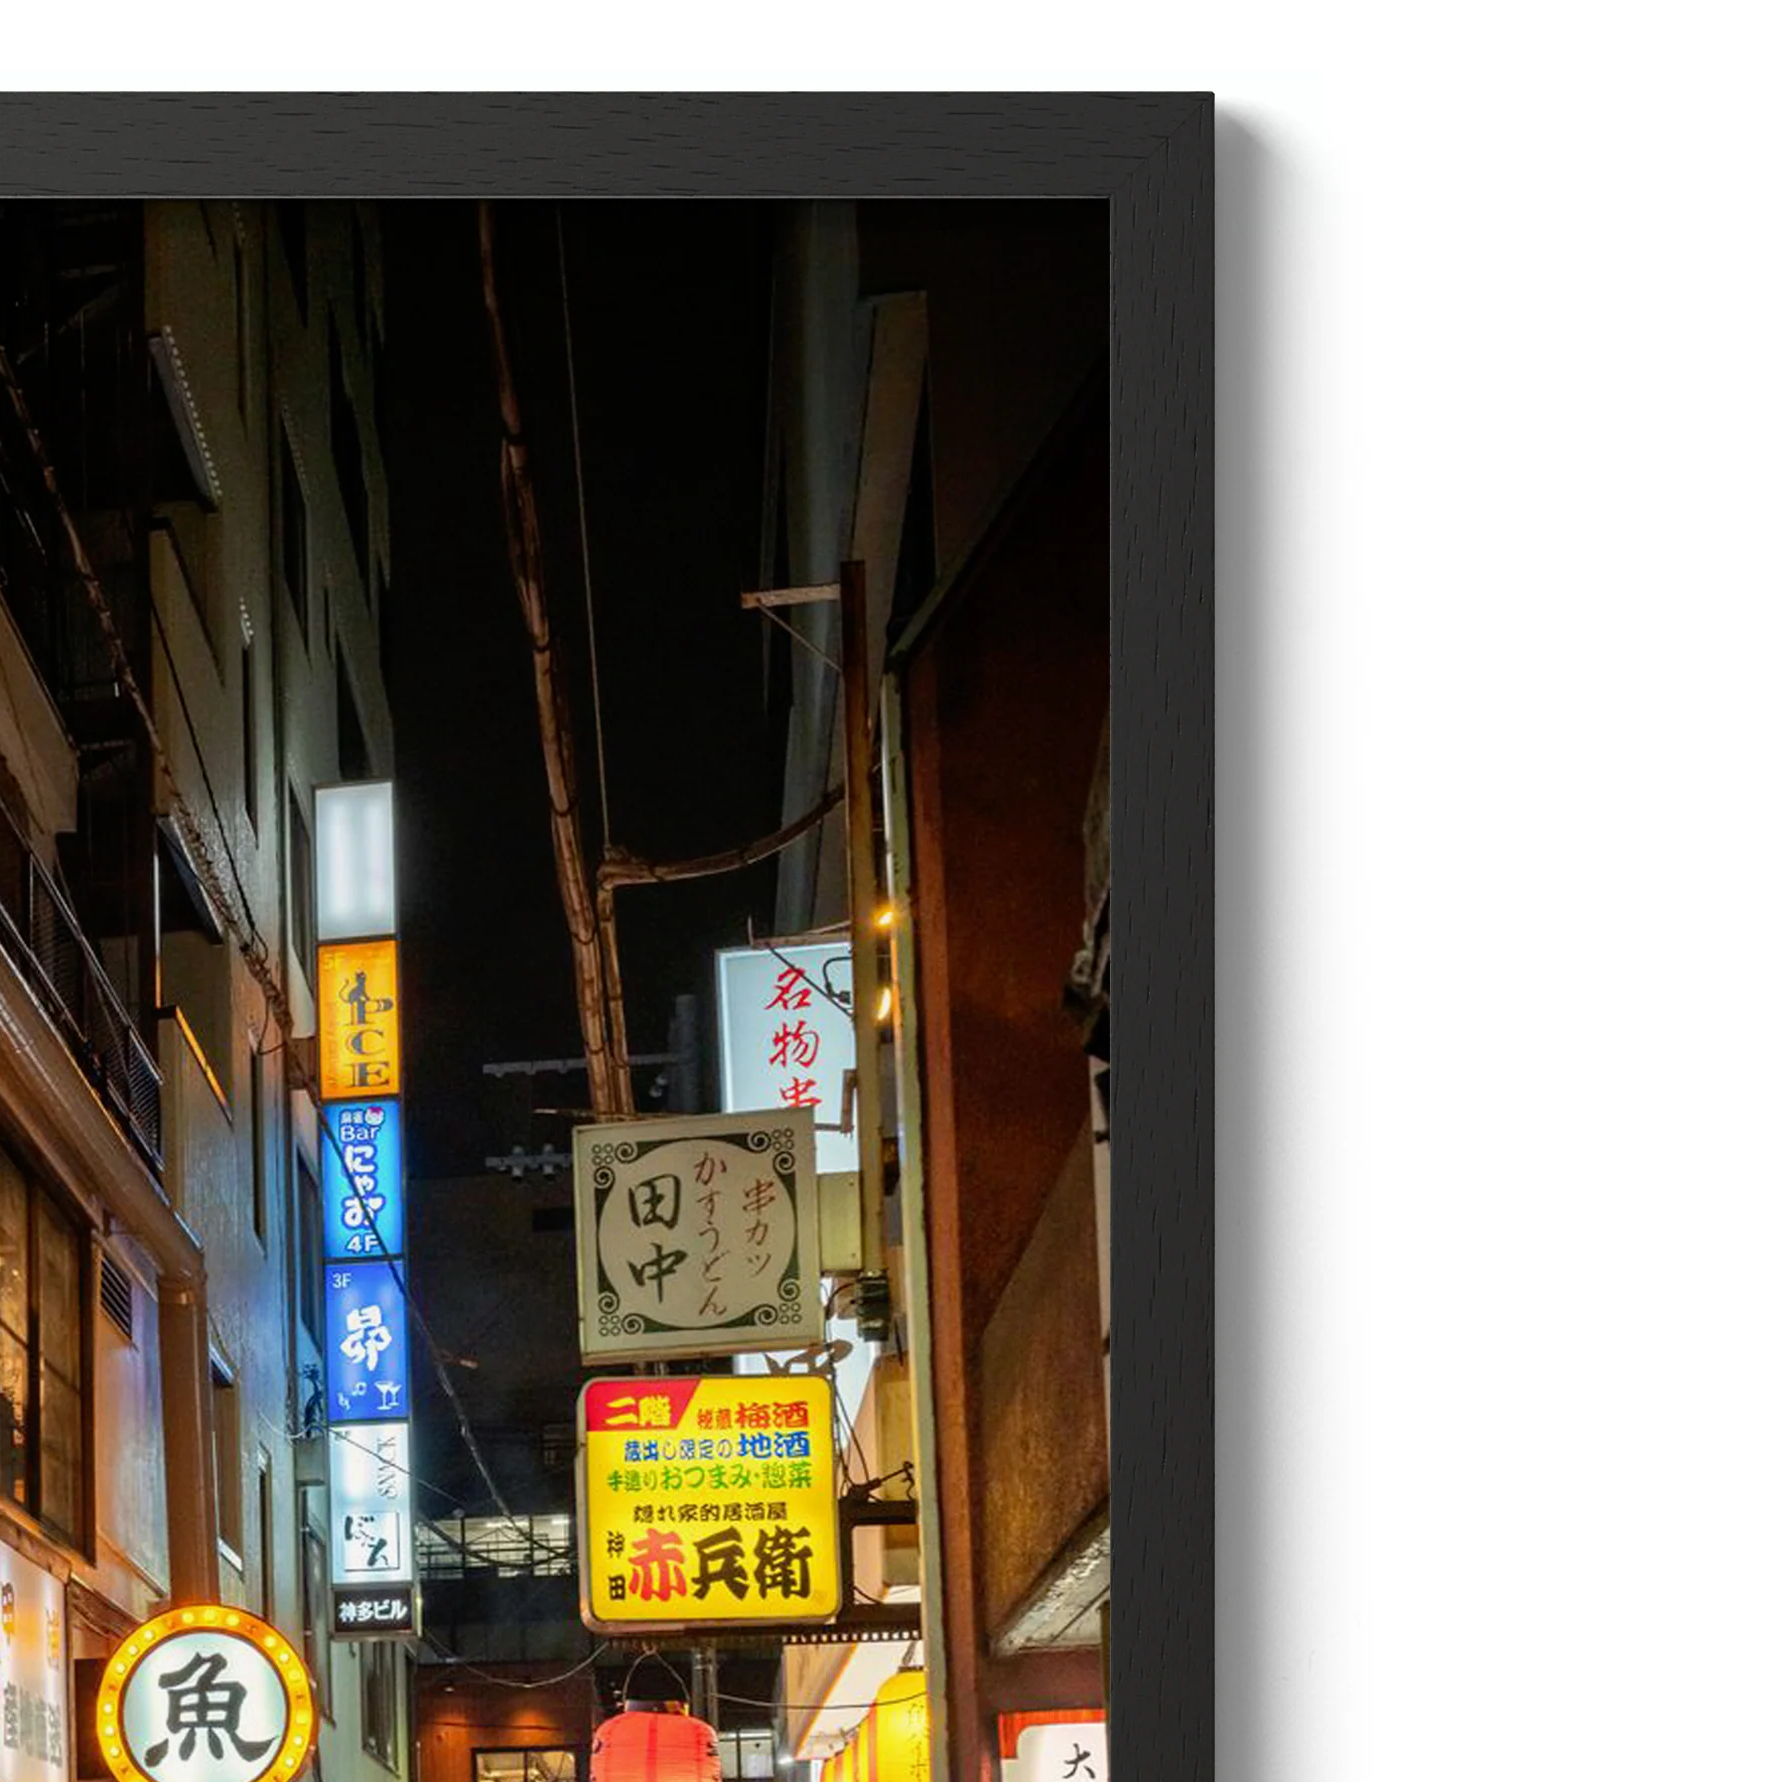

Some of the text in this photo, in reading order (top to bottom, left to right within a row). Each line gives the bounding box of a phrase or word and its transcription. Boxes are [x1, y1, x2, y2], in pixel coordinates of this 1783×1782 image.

[340, 1123, 380, 1142] Bar
[346, 1233, 380, 1254] 4F
[627, 1173, 690, 1304] 田中
[693, 1152, 730, 1318] かすうどん
[742, 1178, 776, 1277] 串カツ
[332, 1273, 352, 1289] 3F
[604, 1394, 673, 1427] 二階
[632, 1502, 788, 1523] 隠れ家的居酒屋
[628, 1525, 815, 1603] 赤兵衛
[338, 1598, 408, 1623] 神多ビル
[144, 1651, 280, 1768] 魚
